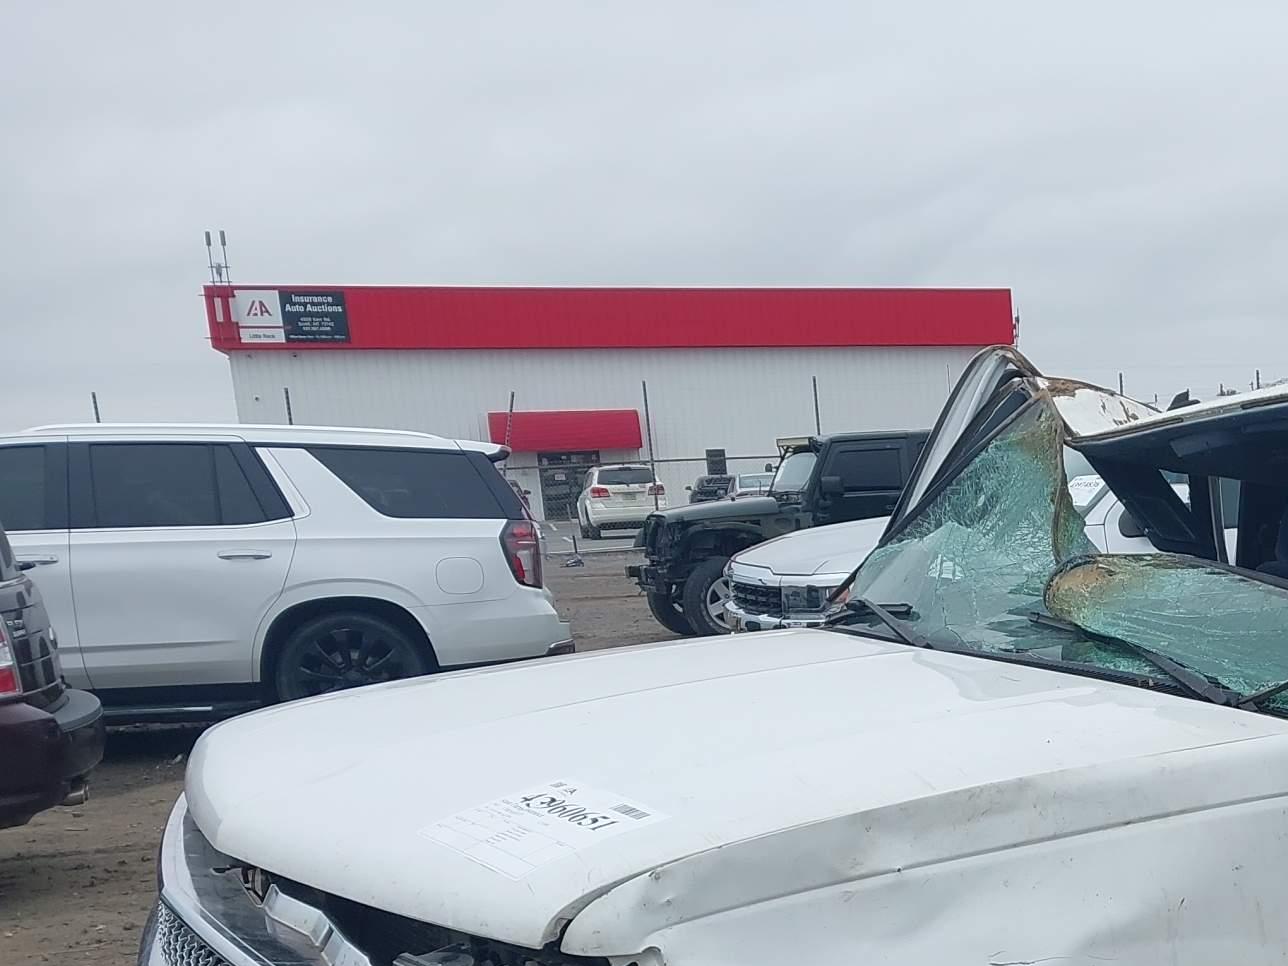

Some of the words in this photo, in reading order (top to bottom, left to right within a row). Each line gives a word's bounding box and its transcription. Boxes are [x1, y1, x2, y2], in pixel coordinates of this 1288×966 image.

[291, 294, 333, 303] Insurance
[285, 303, 305, 312] Auto
[306, 303, 343, 312] Auctions
[519, 792, 620, 832] 43960651
